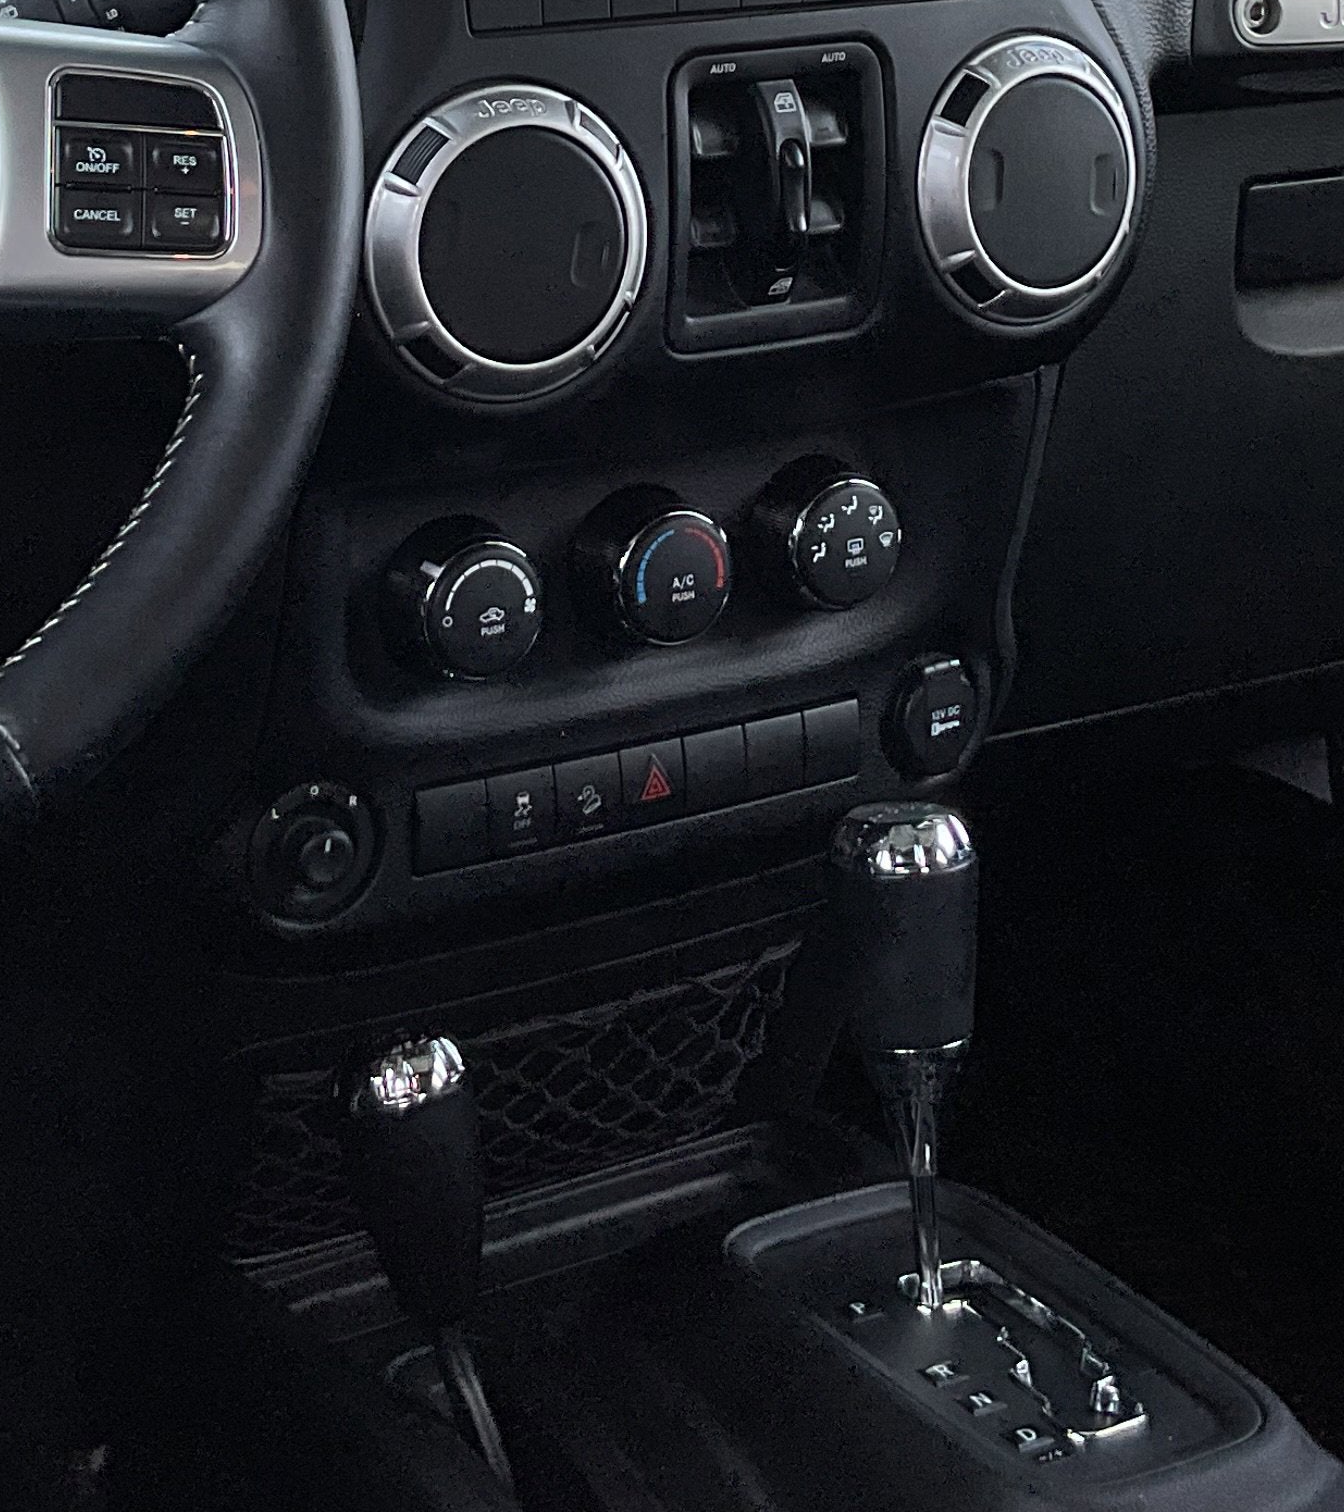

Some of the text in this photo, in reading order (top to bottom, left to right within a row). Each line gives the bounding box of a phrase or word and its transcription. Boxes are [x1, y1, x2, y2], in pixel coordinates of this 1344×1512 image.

[821, 51, 846, 63] AUTO
[1006, 48, 1065, 68] Jeep
[710, 62, 736, 74] AUTO
[477, 97, 547, 119] Jeep
[172, 155, 197, 167] RES
[75, 162, 120, 174] ON/OFF
[73, 209, 121, 222] CANCEL
[174, 207, 197, 219] SET
[845, 556, 867, 568] PUSH
[672, 573, 695, 589] A/C
[671, 590, 695, 602] PUSH
[480, 624, 505, 637] PUSH
[348, 794, 359, 807] R
[271, 807, 280, 820] L
[926, 1362, 954, 1378] R
[969, 1391, 993, 1407] N
[1015, 1428, 1038, 1442] D
